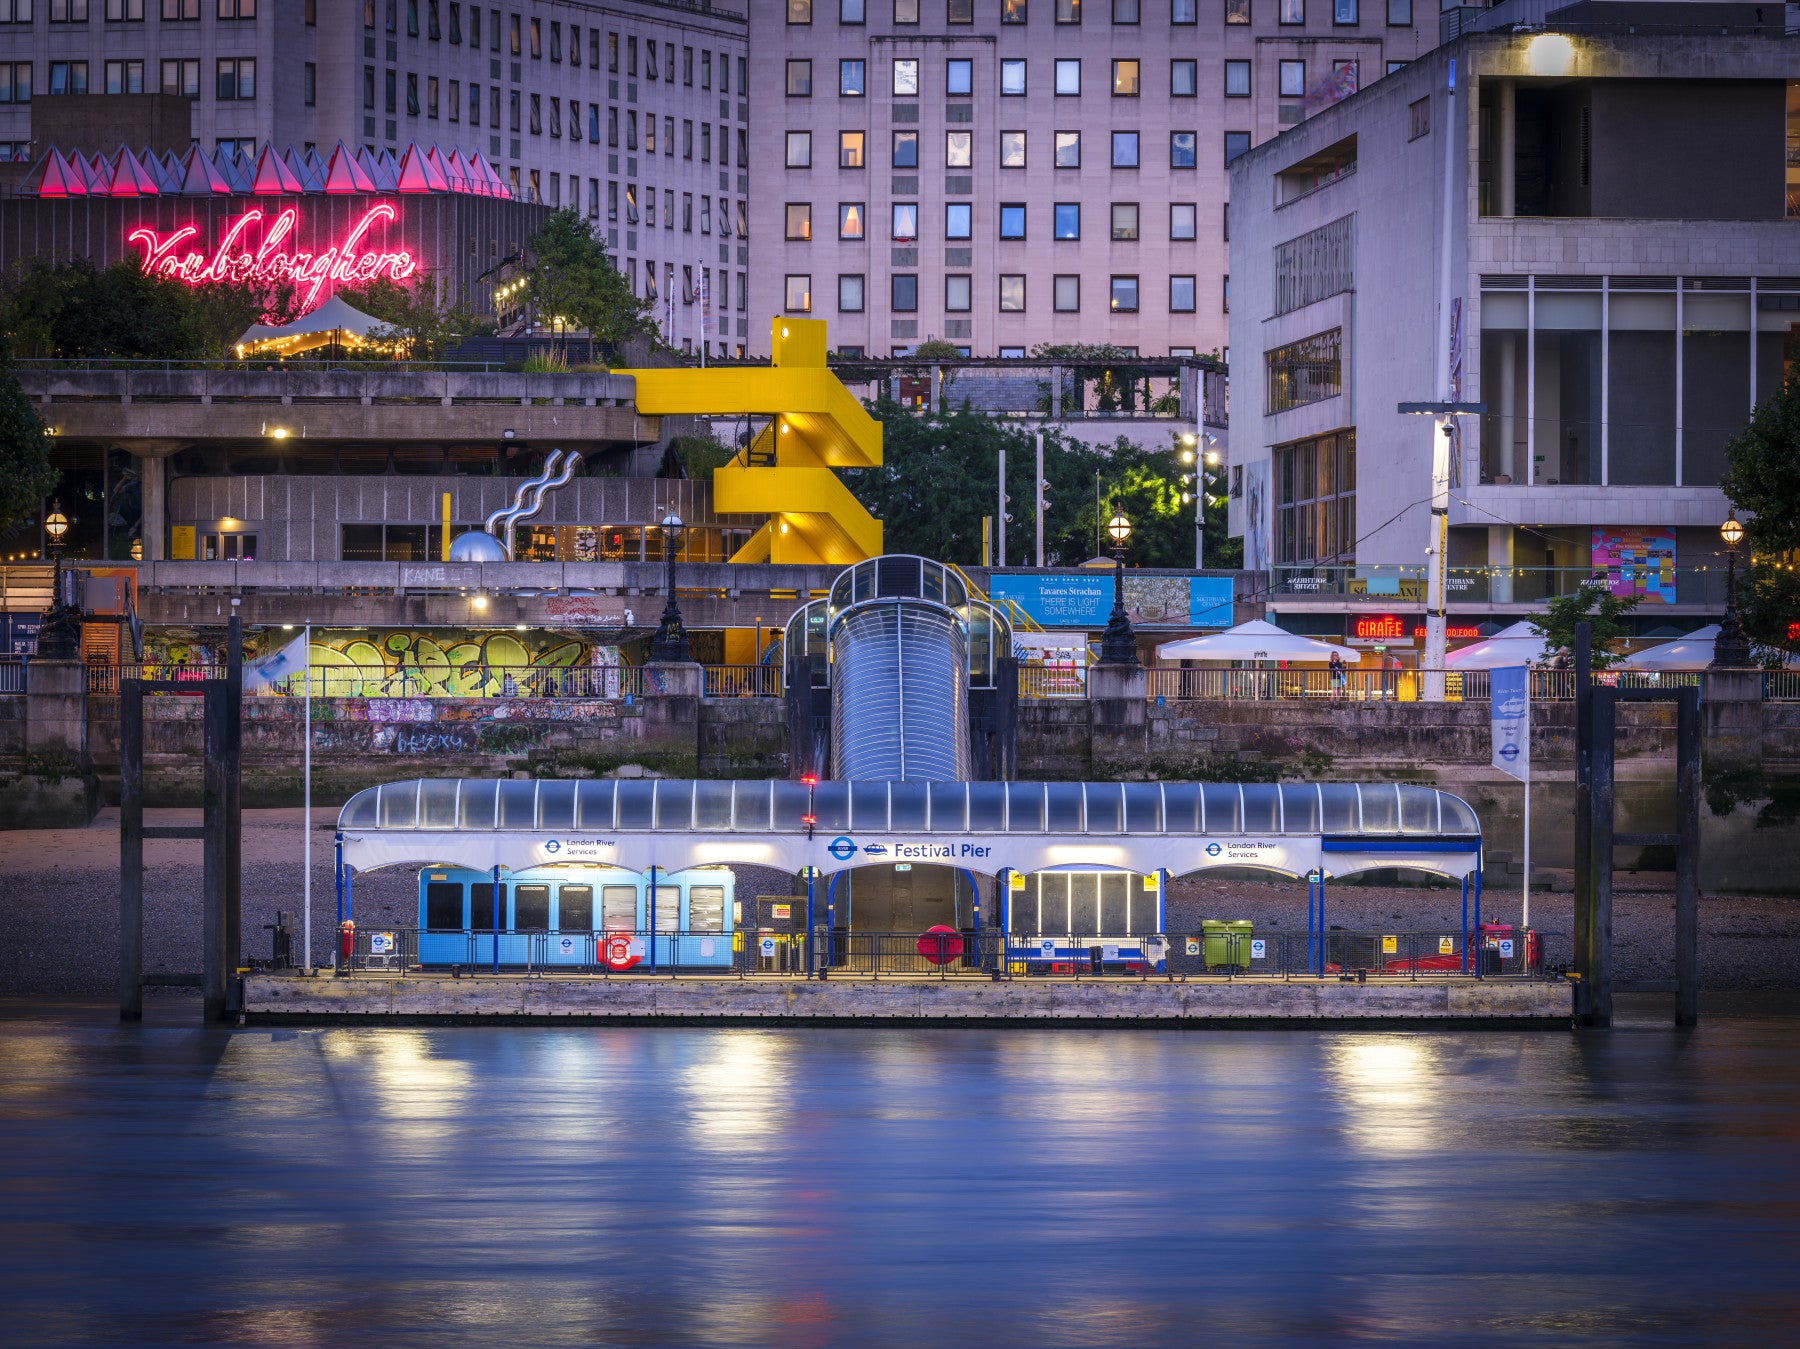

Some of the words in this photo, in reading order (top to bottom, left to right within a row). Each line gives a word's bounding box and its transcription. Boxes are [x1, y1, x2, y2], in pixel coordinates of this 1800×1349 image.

[404, 567, 444, 582] KANE
[1039, 587, 1068, 595] Tavares
[1069, 587, 1102, 595] Strachan
[1041, 598, 1067, 606] THERE
[1068, 598, 1076, 606] IS
[1077, 598, 1101, 606] LIGHT
[1044, 607, 1097, 616] SOMEWHERE
[1358, 617, 1403, 637] GIRAFFE
[1458, 628, 1479, 637] FOOD
[895, 843, 956, 857] Festival
[961, 843, 992, 857] Pier
[1228, 850, 1259, 858] Services
